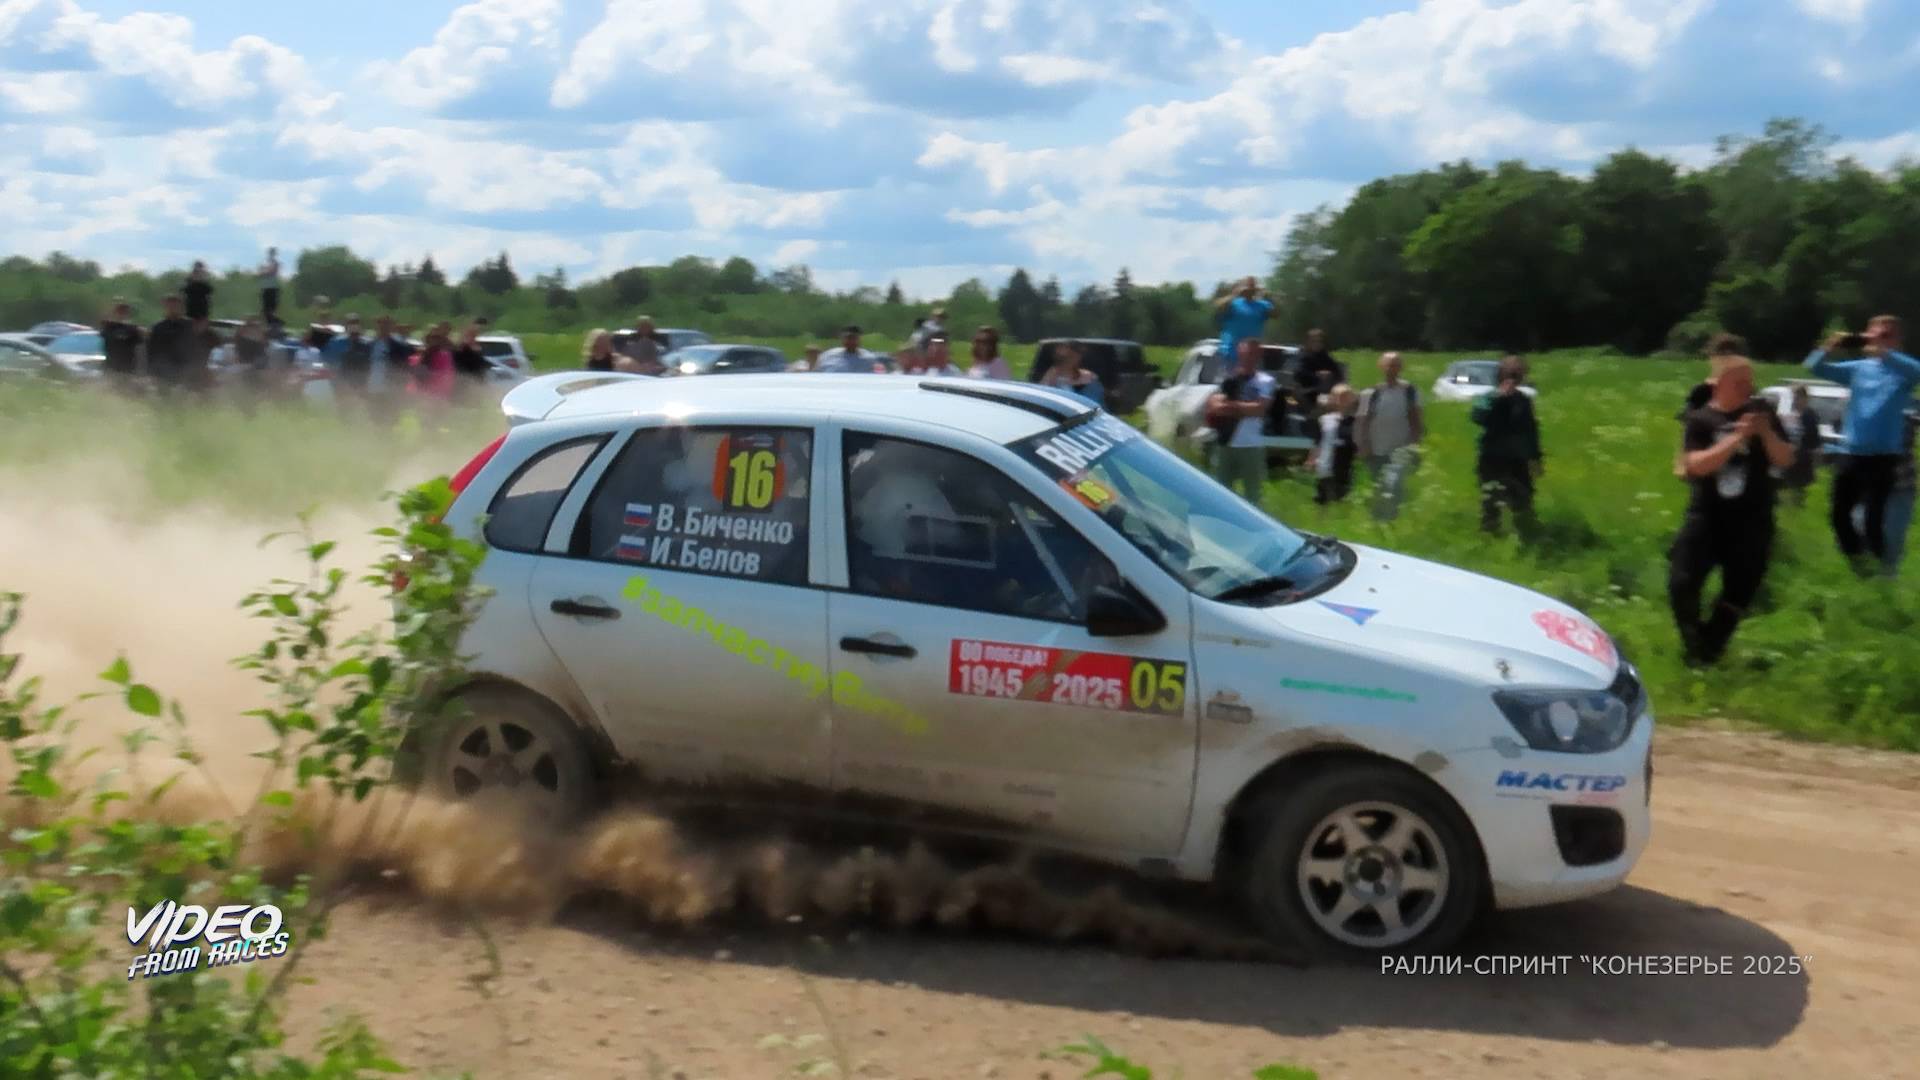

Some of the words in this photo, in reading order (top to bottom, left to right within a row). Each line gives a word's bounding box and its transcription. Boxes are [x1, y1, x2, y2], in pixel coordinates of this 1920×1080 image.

[1035, 428, 1113, 475] RALLY
[729, 450, 776, 509] 16
[656, 503, 793, 544] В.Биченко
[650, 535, 760, 575] И.Белов
[959, 664, 1023, 698] 1945
[1053, 672, 1122, 710] 2025
[1130, 661, 1184, 711] 05
[1496, 770, 1627, 792] МАСТЕР
